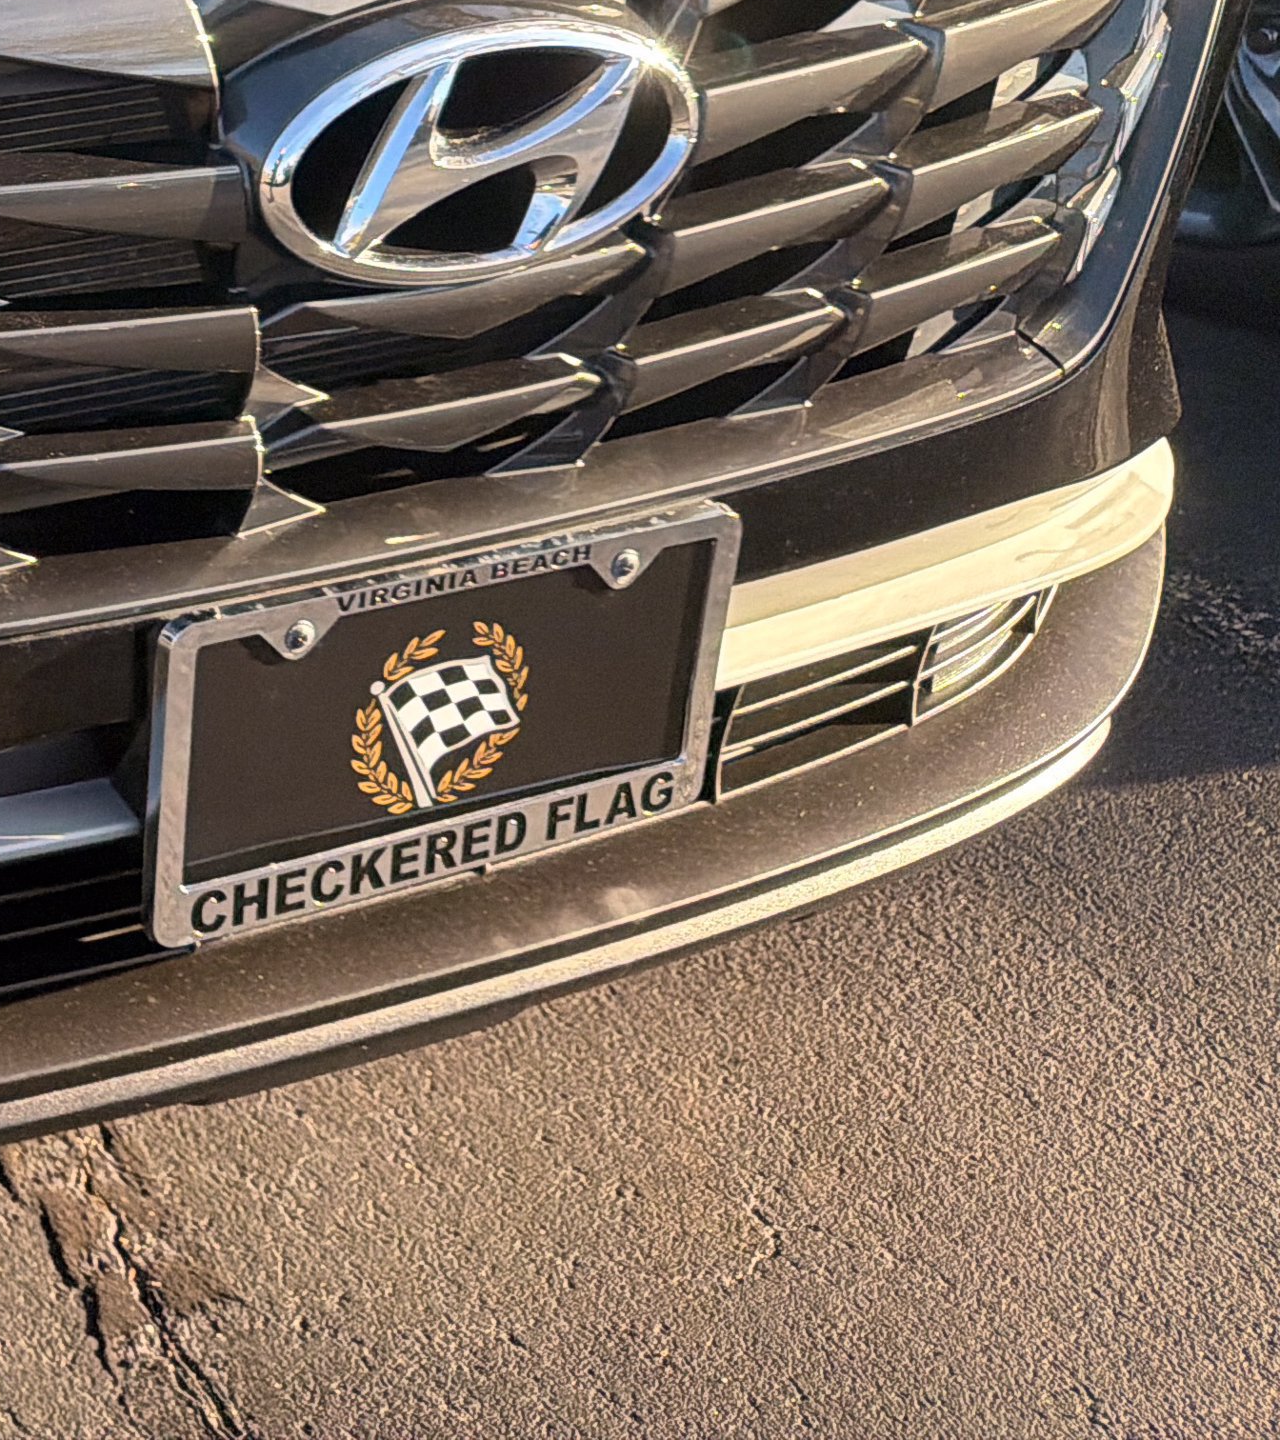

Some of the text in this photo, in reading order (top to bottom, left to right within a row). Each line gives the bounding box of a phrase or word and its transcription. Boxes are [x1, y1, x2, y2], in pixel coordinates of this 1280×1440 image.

[336, 543, 591, 612] VIRGINIA BEACH
[190, 771, 675, 934] CHECKERED FLAG
